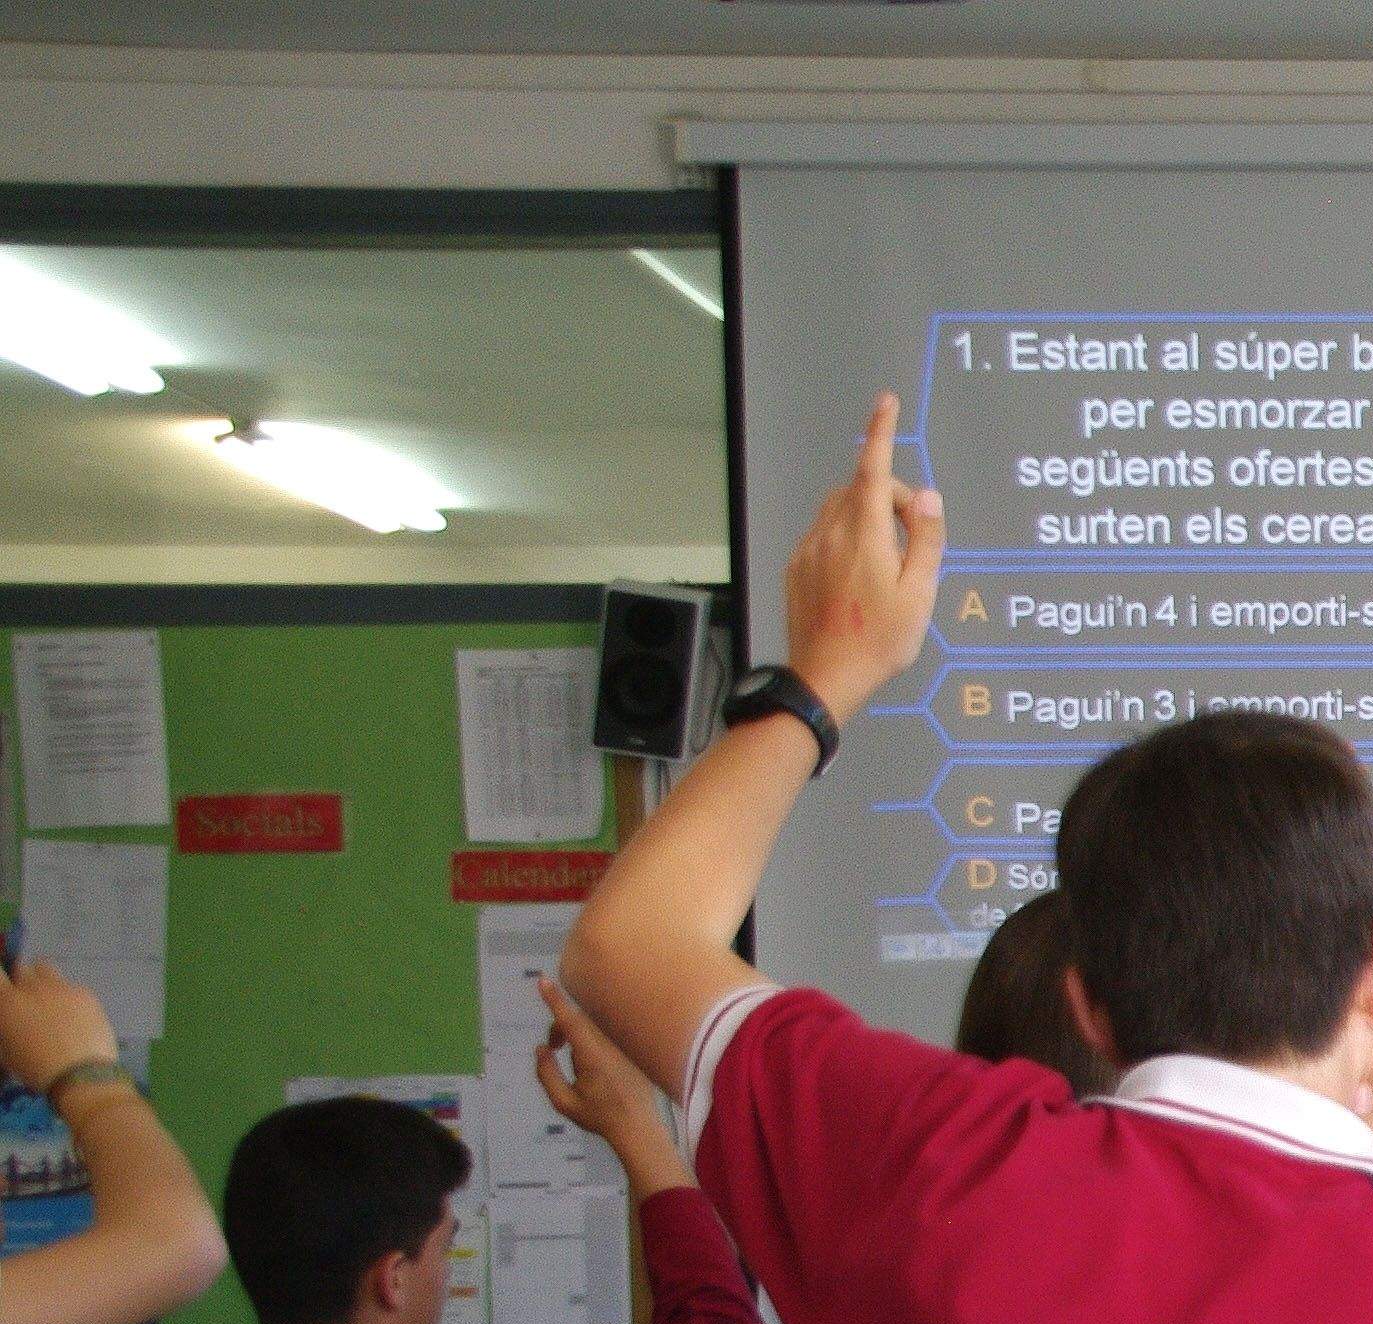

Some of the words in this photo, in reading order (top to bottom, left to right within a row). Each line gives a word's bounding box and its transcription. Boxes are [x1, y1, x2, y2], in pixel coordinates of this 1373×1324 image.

[953, 330, 992, 372] 1.
[1008, 331, 1149, 372] Estant
[1161, 332, 1200, 372] al
[1214, 331, 1338, 381] súper
[1082, 397, 1155, 439] per
[1165, 398, 1371, 430] esmorzar
[1016, 449, 1216, 498] següents
[1037, 507, 1172, 545] surten
[1184, 506, 1249, 545] els
[957, 589, 989, 623] A
[1008, 594, 1148, 636] Pagui'n
[1154, 594, 1179, 628] 4
[1188, 594, 1198, 628] i
[961, 683, 993, 718] B
[1006, 688, 1145, 731] Pagui'n
[1153, 688, 1177, 723] 3
[1186, 688, 1197, 721] i
[965, 794, 996, 829] C
[966, 857, 998, 890] D
